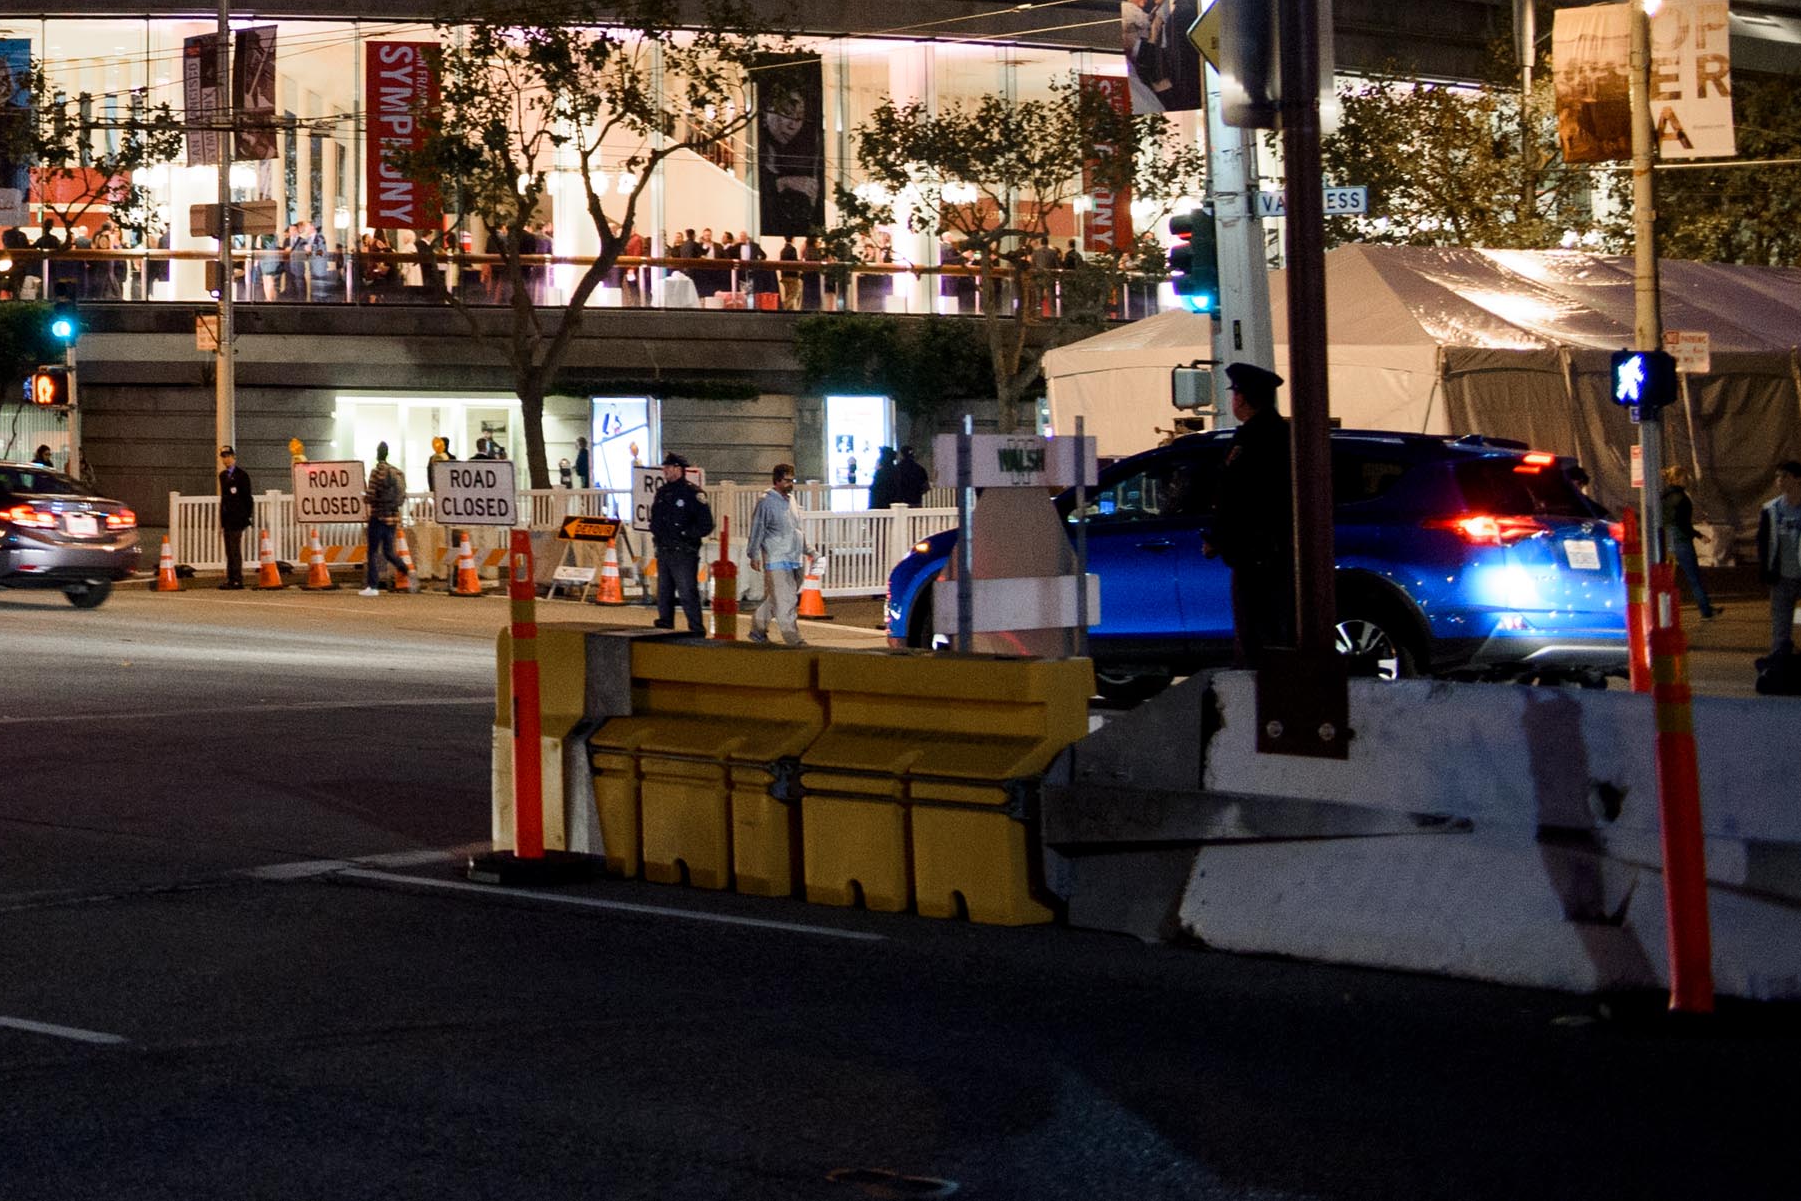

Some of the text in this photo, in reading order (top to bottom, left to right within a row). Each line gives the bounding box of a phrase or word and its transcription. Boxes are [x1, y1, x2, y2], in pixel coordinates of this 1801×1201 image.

[416, 46, 428, 67] AN
[202, 91, 216, 163] SYMNY
[1326, 191, 1361, 210] ESS
[309, 469, 349, 488] ROAD
[450, 469, 497, 489] ROAD
[644, 475, 664, 493] RO
[301, 497, 360, 515] CLOSED
[441, 497, 509, 517] CLOSED
[576, 524, 612, 536] DETOUR
